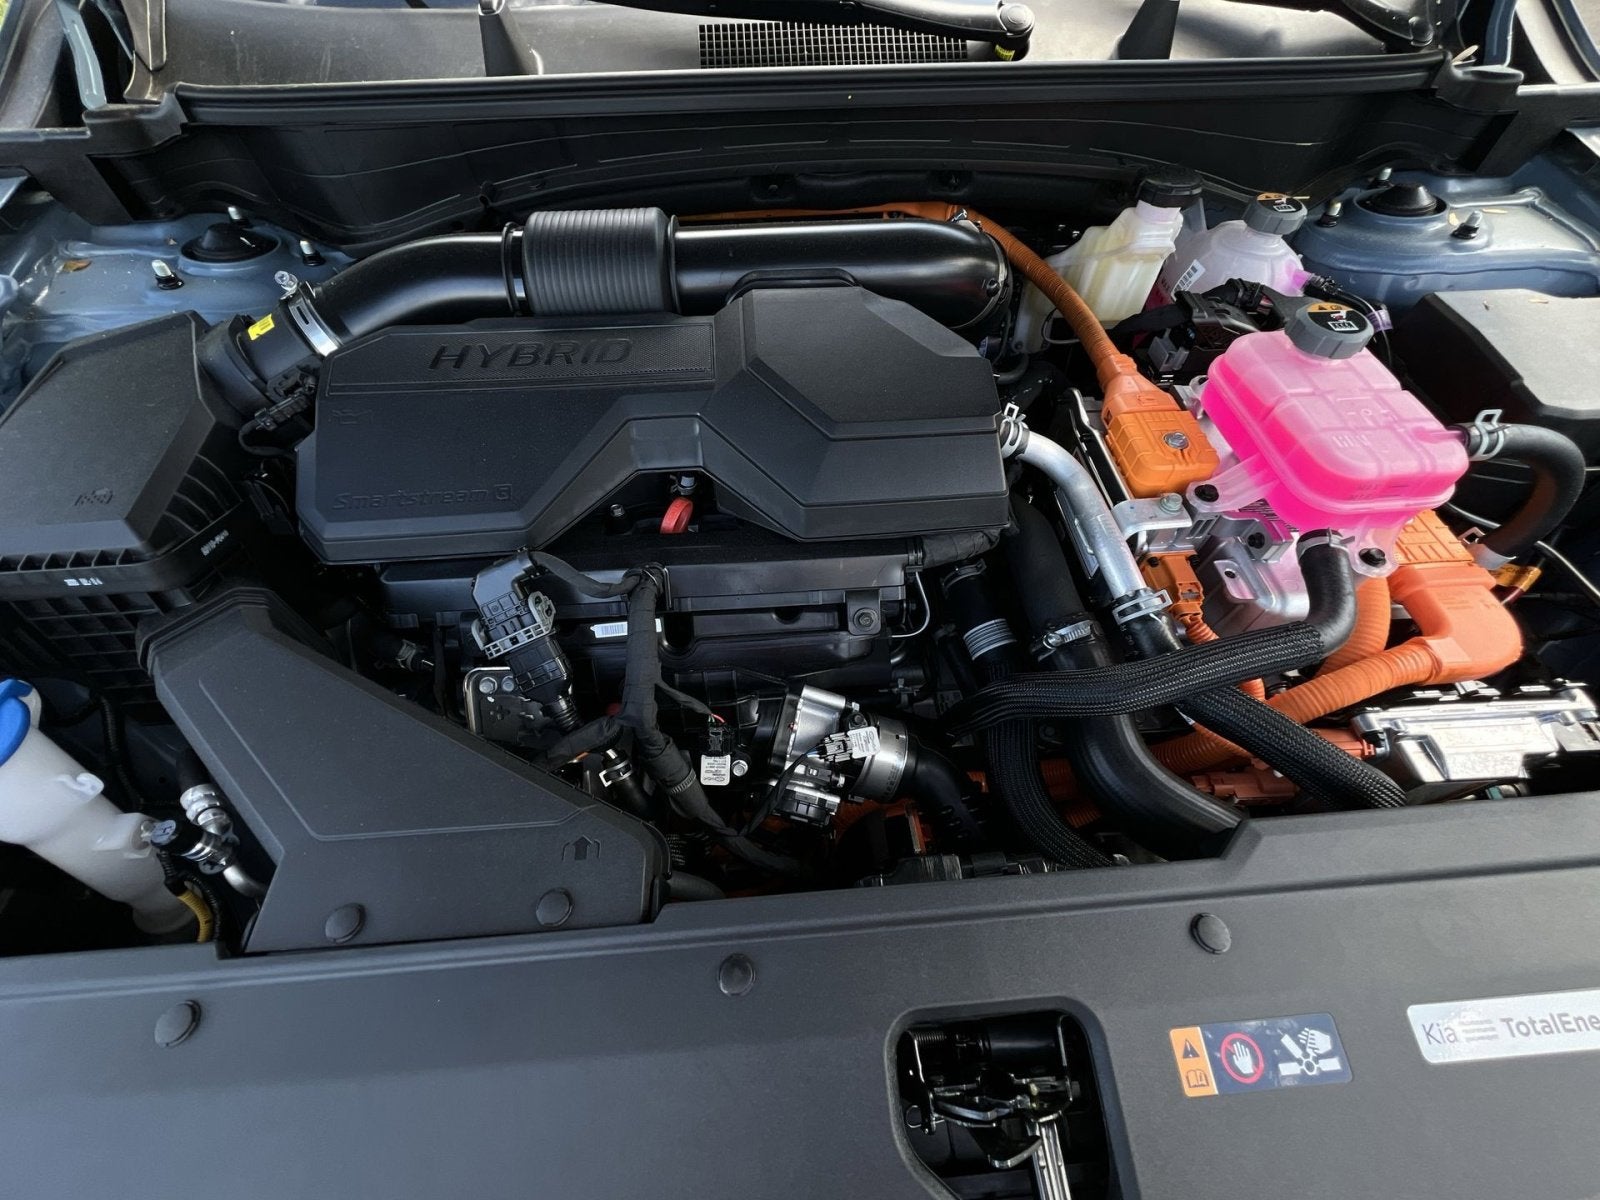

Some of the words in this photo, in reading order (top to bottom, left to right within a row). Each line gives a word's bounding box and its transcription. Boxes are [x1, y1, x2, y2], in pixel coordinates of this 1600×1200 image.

[428, 338, 633, 369] HYBRID
[332, 489, 488, 511] Smartstream
[1422, 1023, 1460, 1045] Kia
[1500, 1012, 1600, 1038] TotalEne
